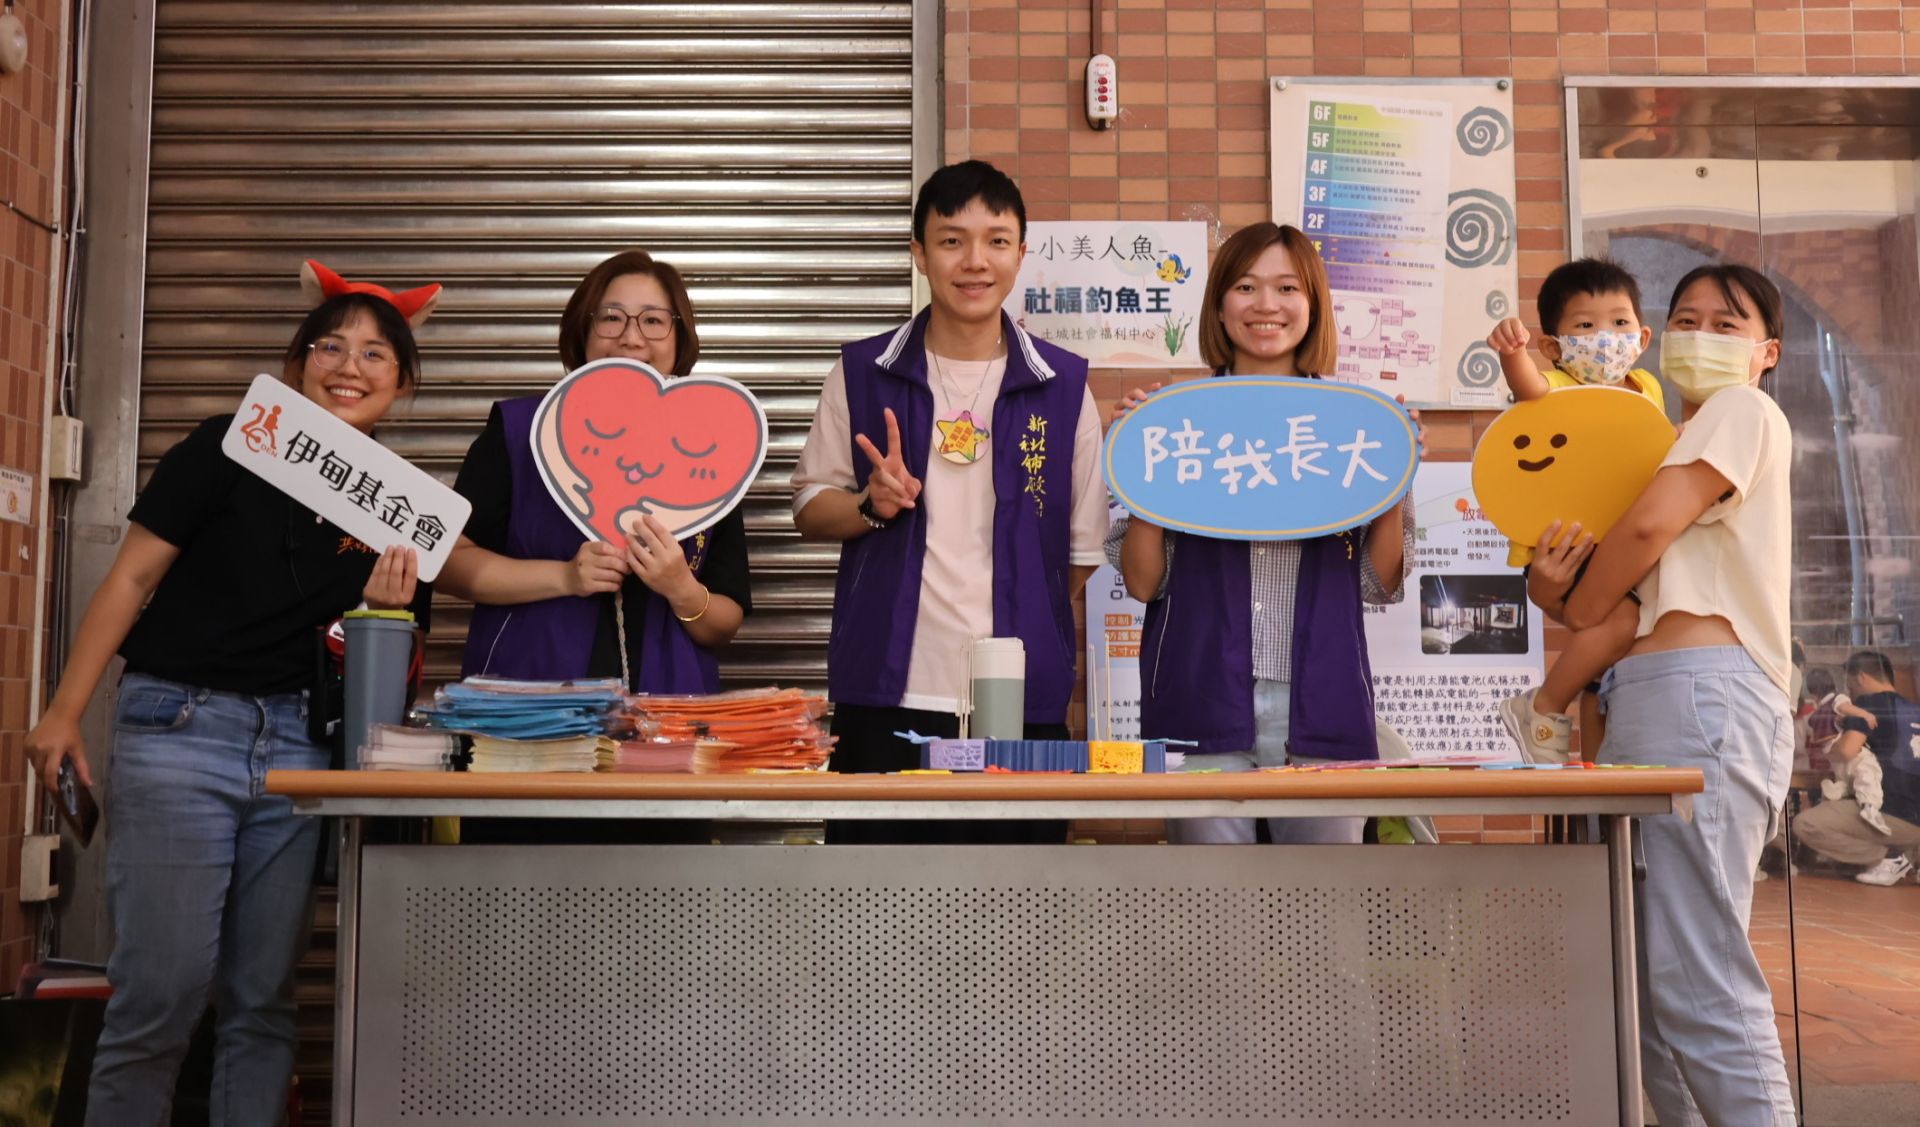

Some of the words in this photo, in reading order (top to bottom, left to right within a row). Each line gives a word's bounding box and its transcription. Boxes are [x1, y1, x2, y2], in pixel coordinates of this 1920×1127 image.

[1313, 105, 1331, 121] 6F
[1312, 132, 1330, 149] 5F
[1310, 159, 1328, 175] 4F
[1309, 186, 1326, 202] 3F
[1307, 213, 1325, 229] 2F
[1024, 286, 1172, 314] 社福釣魚王
[1041, 327, 1156, 341] 土城社會福利中心
[1143, 414, 1389, 495] 陪我長大
[284, 430, 447, 552] 伊甸基金會
